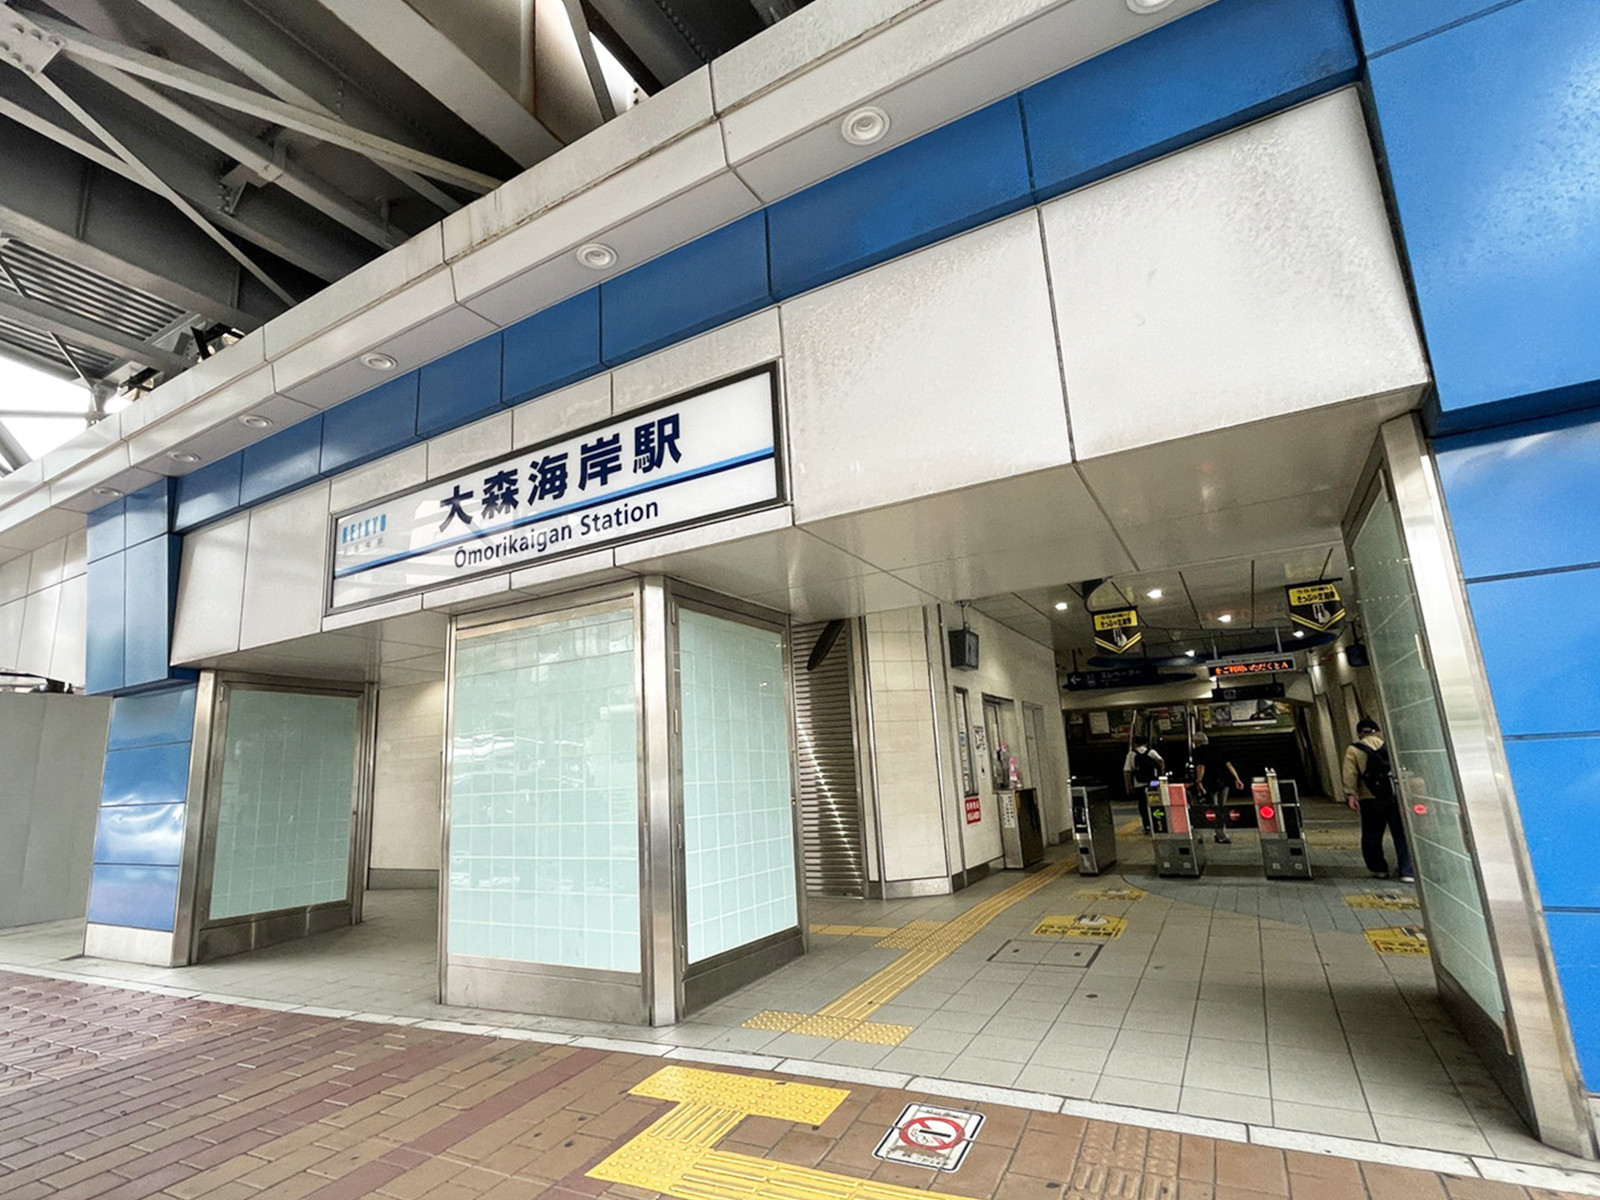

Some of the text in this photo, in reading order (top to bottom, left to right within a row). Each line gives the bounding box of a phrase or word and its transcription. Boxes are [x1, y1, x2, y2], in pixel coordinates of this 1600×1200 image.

[439, 413, 682, 532] 大森海岸駅
[454, 501, 659, 569] Ōmorikaigan Station
